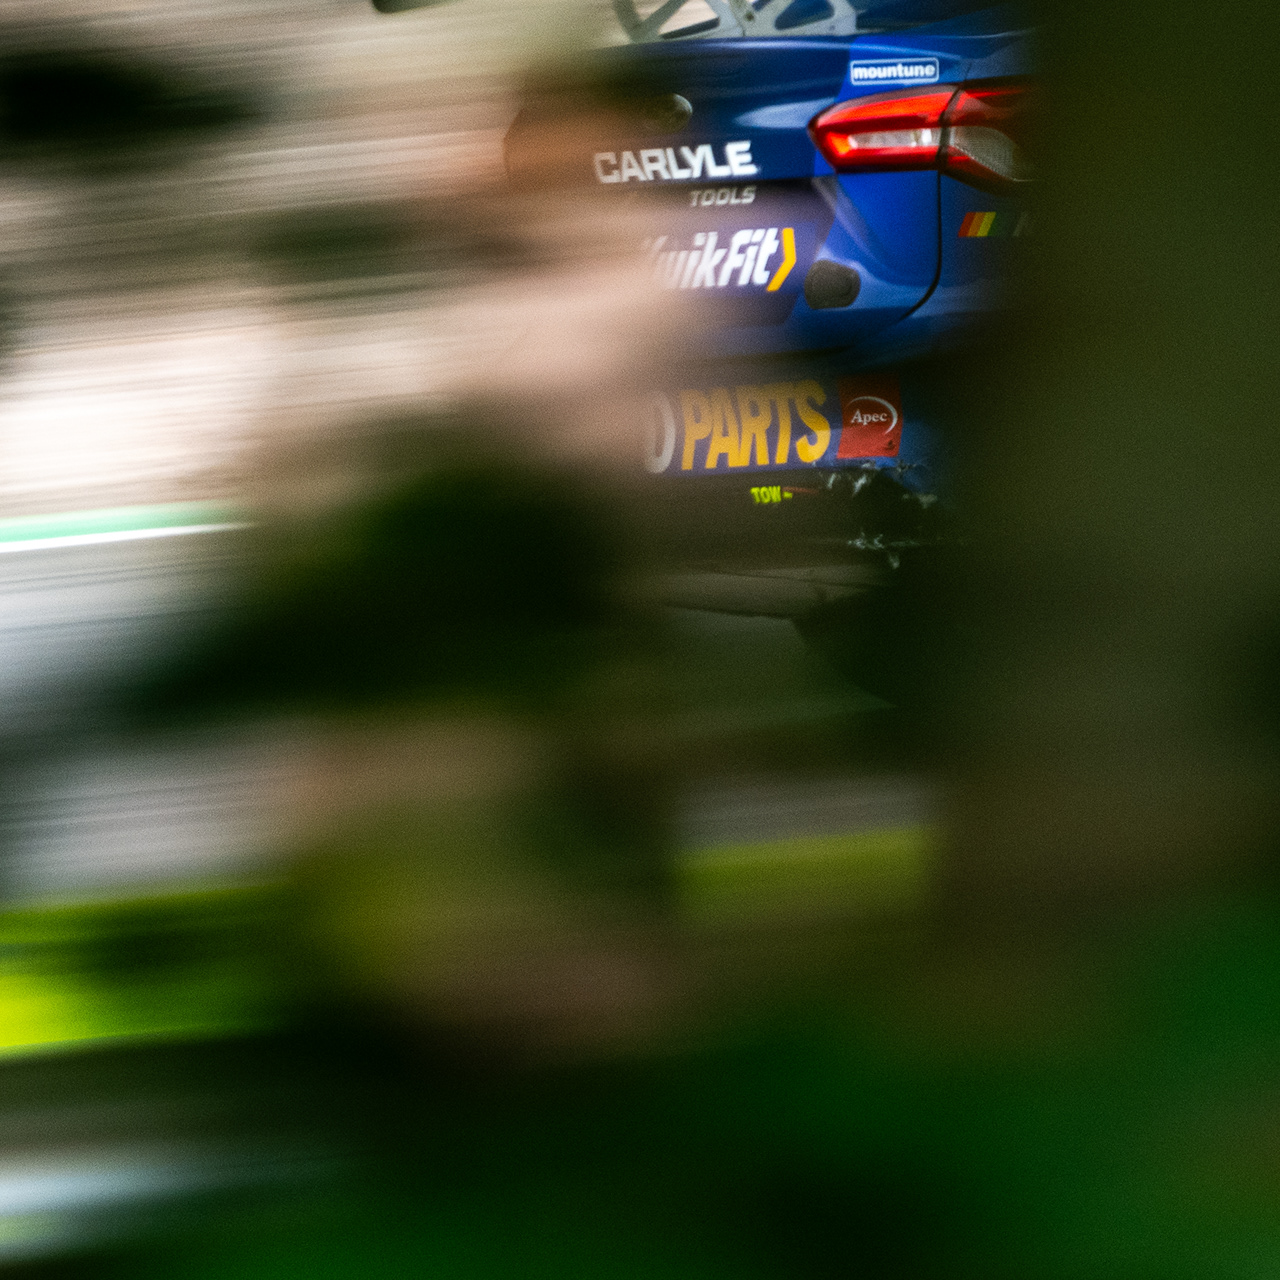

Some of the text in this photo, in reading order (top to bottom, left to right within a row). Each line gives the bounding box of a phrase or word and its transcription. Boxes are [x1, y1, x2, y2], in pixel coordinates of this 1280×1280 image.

[853, 63, 937, 81] mountune
[594, 140, 758, 184] CARLYLE
[690, 186, 757, 207] TOOLS
[679, 379, 832, 471] PARTS
[851, 409, 889, 425] Apec
[751, 485, 782, 503] TOW
